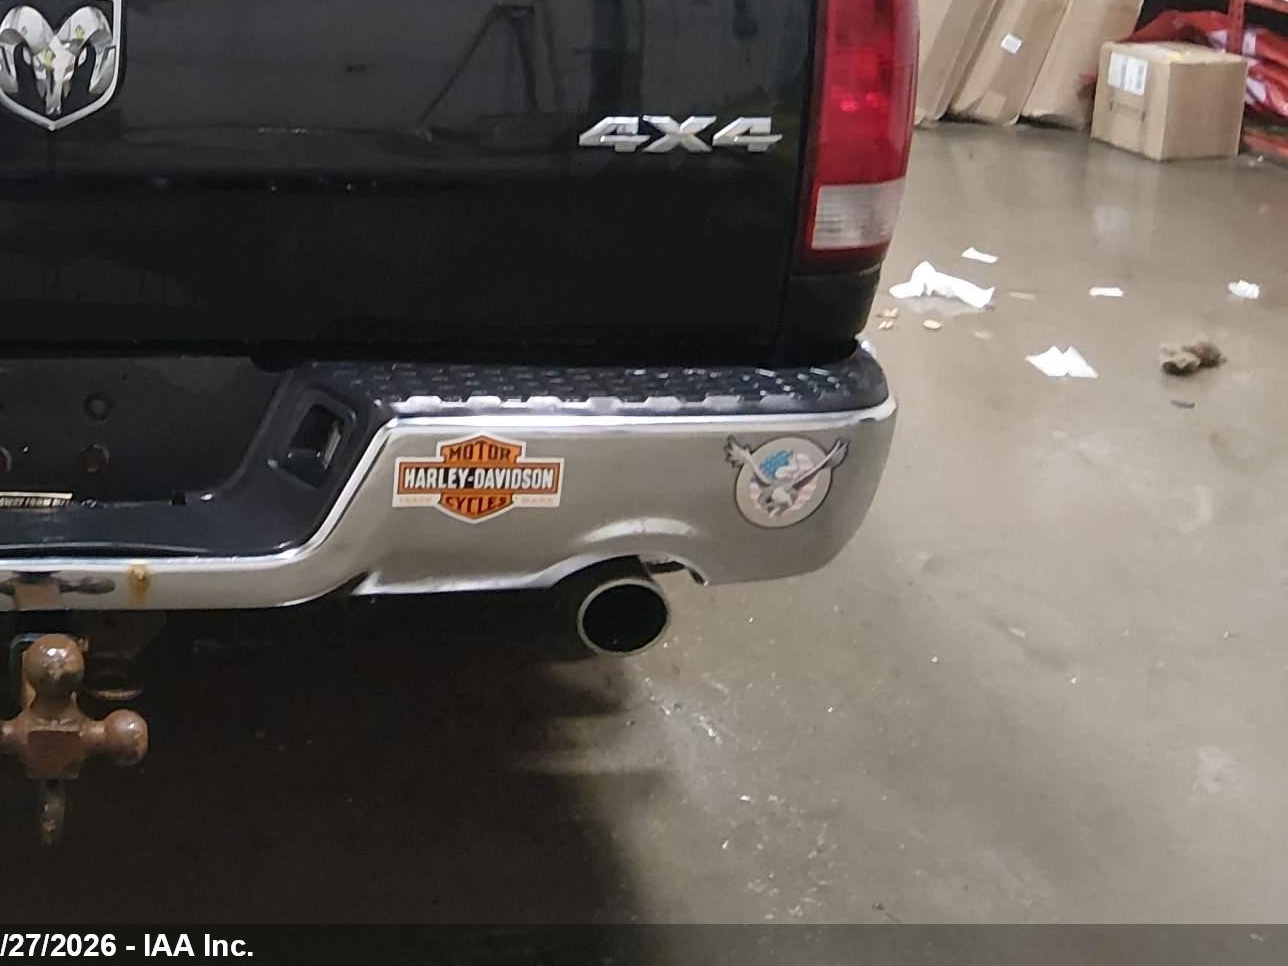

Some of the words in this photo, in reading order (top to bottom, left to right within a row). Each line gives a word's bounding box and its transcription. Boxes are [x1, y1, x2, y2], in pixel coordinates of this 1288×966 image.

[448, 440, 512, 461] MOTOR
[404, 468, 554, 490] HARLEY-DAVIDSON
[445, 495, 508, 515] CYCLES
